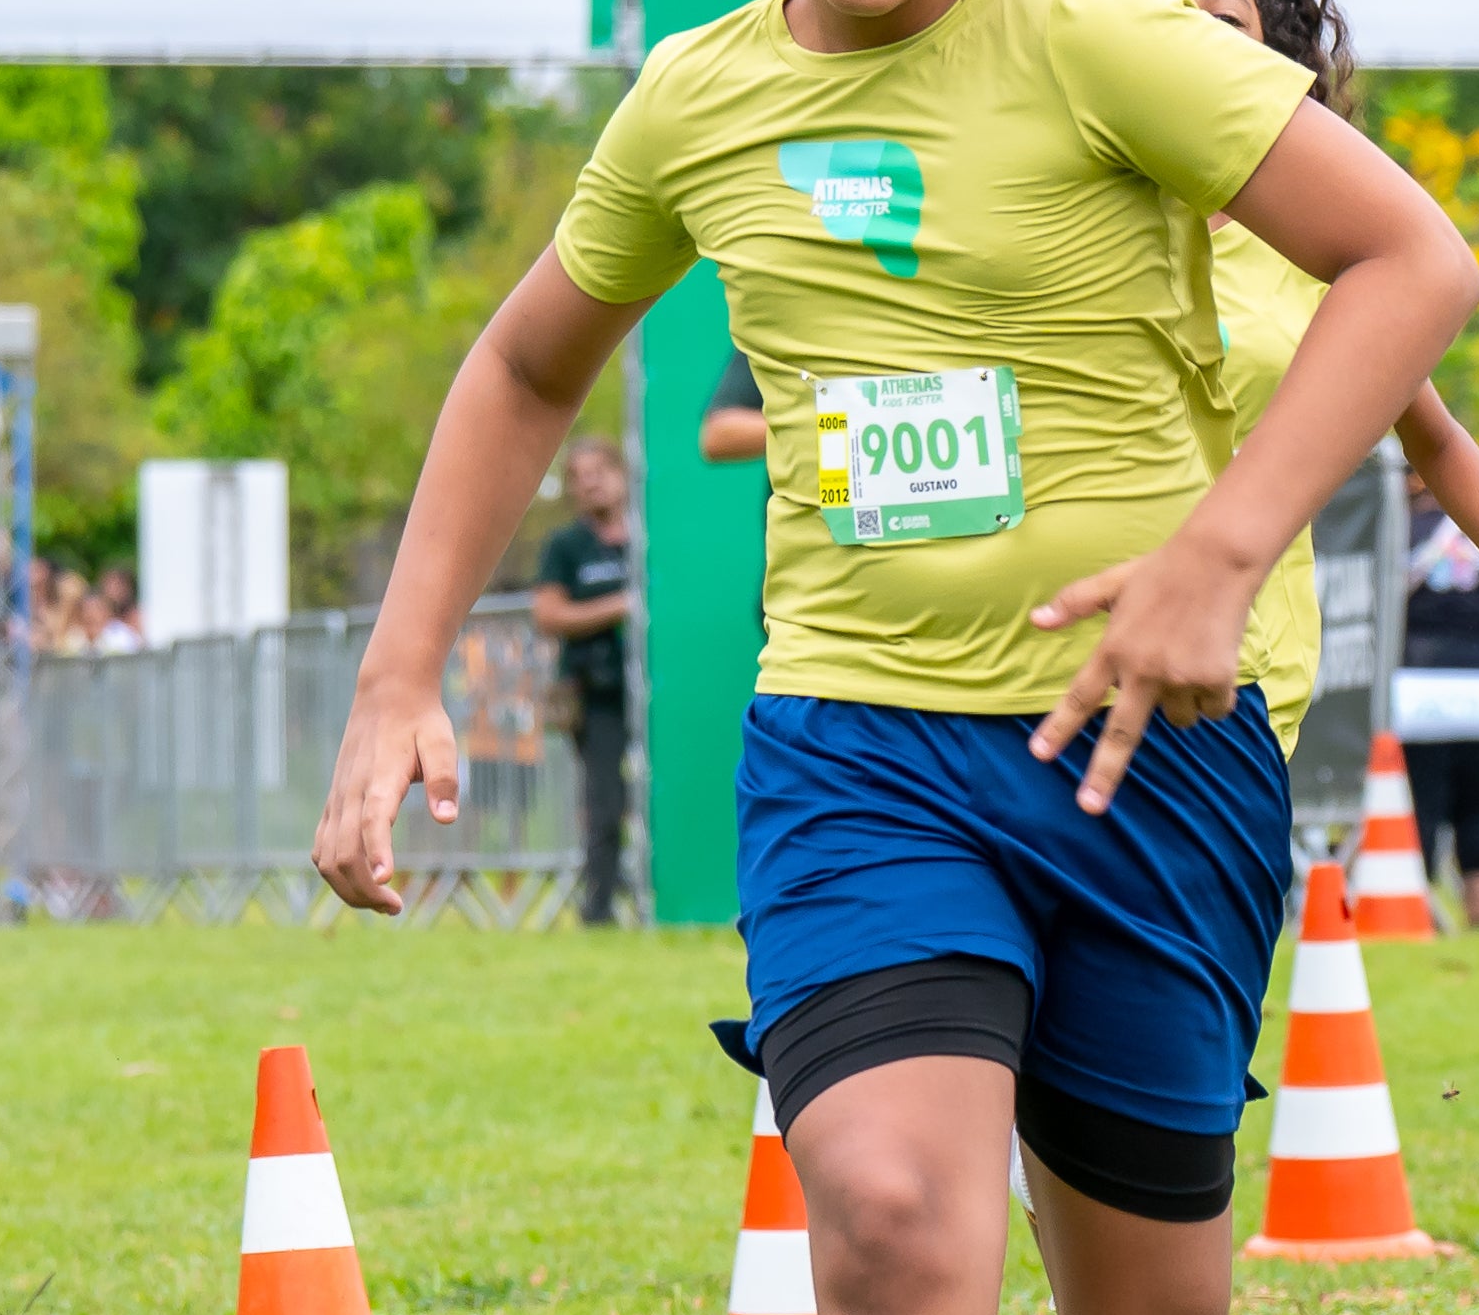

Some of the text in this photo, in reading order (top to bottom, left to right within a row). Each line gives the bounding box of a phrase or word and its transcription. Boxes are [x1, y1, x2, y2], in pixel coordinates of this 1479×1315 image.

[811, 175, 894, 202] ATHENAS
[810, 200, 891, 218] KIDS FASTER
[880, 375, 944, 395] ATHENAS
[818, 417, 848, 430] 400m
[860, 415, 990, 476] 9001
[909, 478, 958, 493] GUSTAVO
[821, 488, 850, 504] 2012
